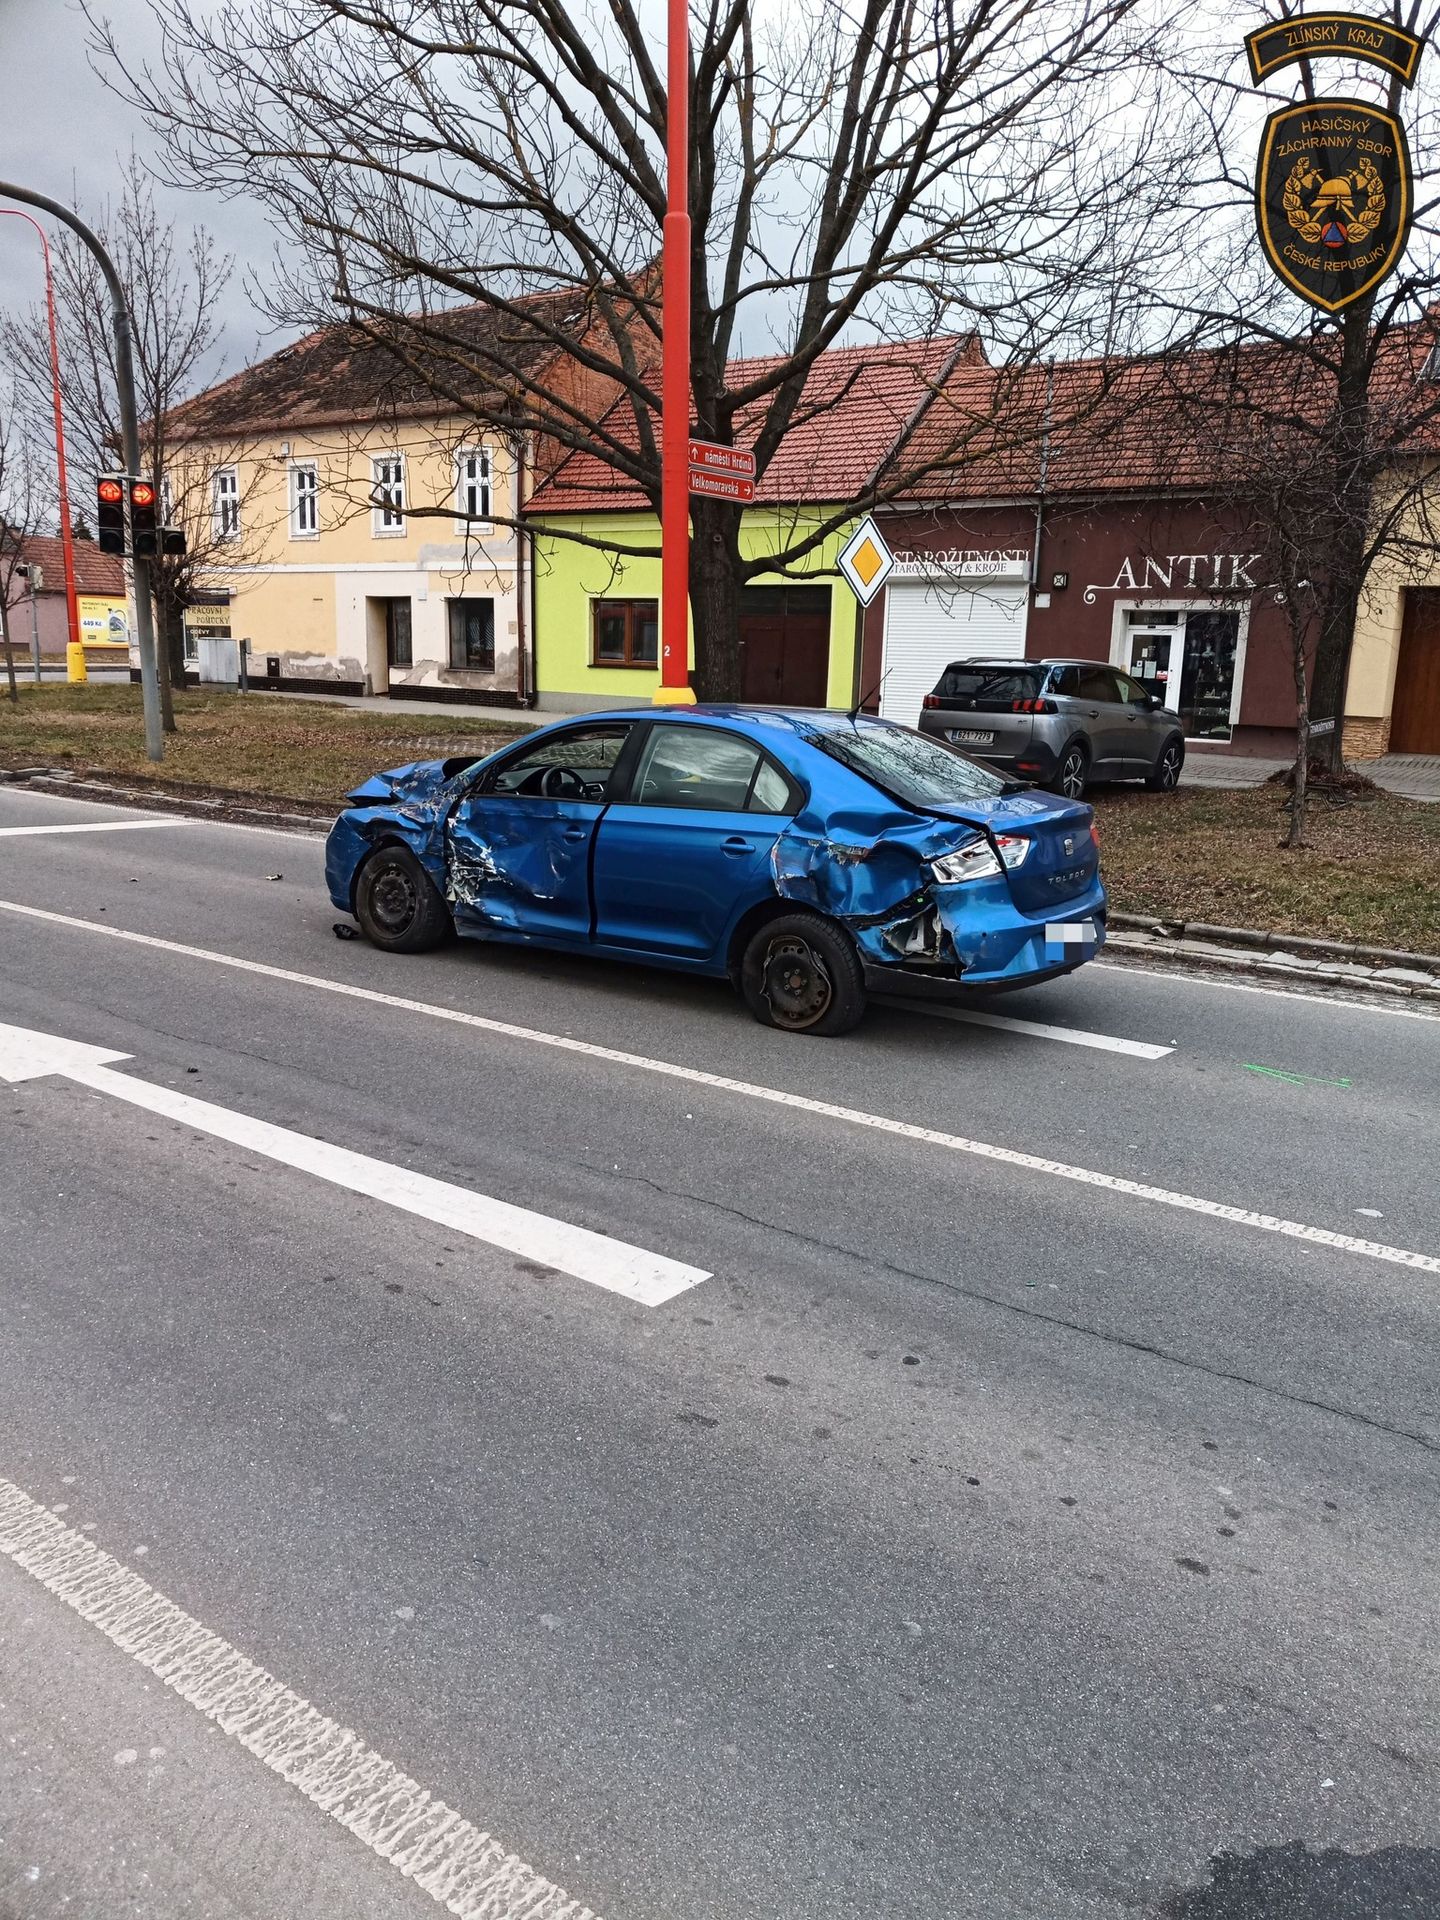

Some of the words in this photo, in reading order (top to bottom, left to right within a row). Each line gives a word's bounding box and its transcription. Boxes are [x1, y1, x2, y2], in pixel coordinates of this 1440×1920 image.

[691, 473, 739, 495] Velkomoravská
[964, 563, 972, 573] &
[975, 562, 1007, 574] KROJE
[1113, 554, 1262, 589] ANTIK
[664, 645, 671, 657] 2
[1048, 869, 1086, 885] TOLEDO
